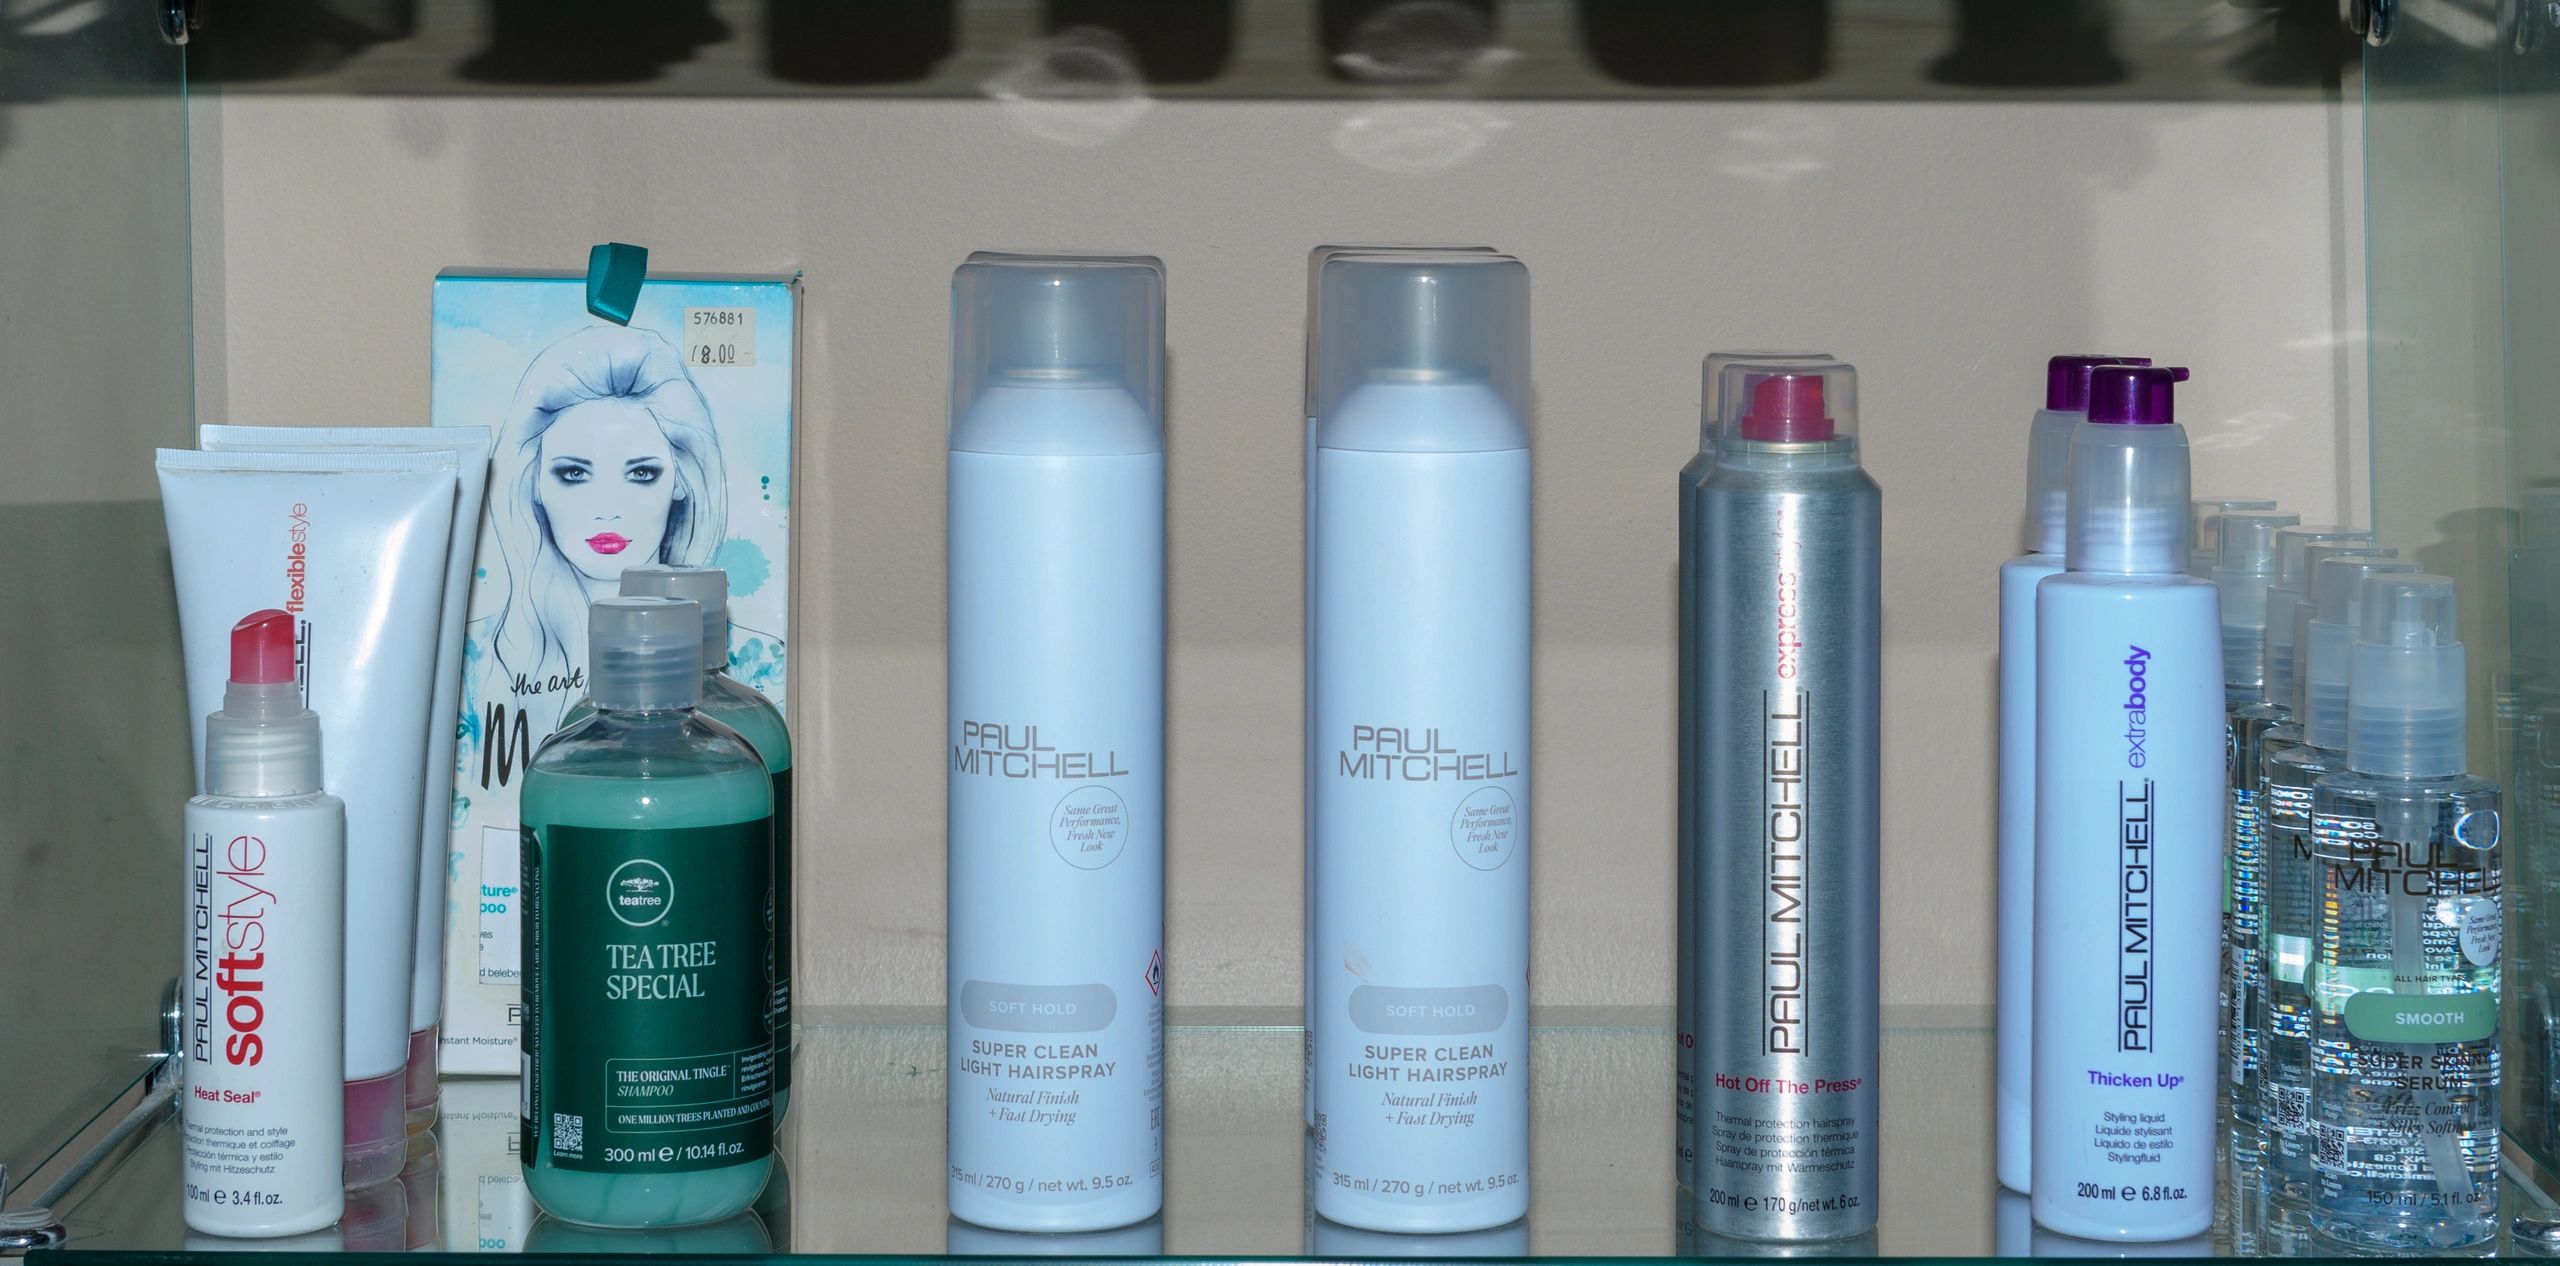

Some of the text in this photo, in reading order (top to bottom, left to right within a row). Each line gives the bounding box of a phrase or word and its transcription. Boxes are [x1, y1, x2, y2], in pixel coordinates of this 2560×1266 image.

[694, 312, 743, 326] 576881
[510, 667, 584, 697] the art
[2124, 644, 2150, 768] extrabody
[964, 720, 1055, 750] PAUL
[1354, 725, 1456, 754] PAUL
[954, 746, 1129, 778] MITCHELL
[1340, 750, 1518, 782] MITCHELL
[1064, 803, 1118, 815] Same Great
[1464, 804, 1510, 817] Same Great
[1067, 829, 1115, 840] Fresh New
[1467, 829, 1508, 842] Fresh New
[1080, 842, 1104, 852] Look
[1478, 842, 1498, 854] Look
[2350, 842, 2458, 868] PAUL
[619, 895, 662, 906] teatree
[216, 835, 276, 1066] softstyle
[606, 942, 716, 970] TEA TREE
[606, 974, 705, 1000] SPECIAL
[1770, 933, 1801, 1053] PAUL
[989, 1001, 1076, 1016] SOFT HOLD
[1386, 1005, 1475, 1018] SOFT HOLD
[2124, 960, 2148, 1051] PAUL
[195, 987, 210, 1062] PAUL
[2396, 1012, 2464, 1025] SMOOTH
[972, 1040, 1098, 1059] SUPER CLEAN
[1365, 1044, 1493, 1062] SUPER CLEAN
[617, 1071, 638, 1082] THE
[640, 1069, 692, 1082] ORIGINAL
[960, 1058, 1116, 1080] LIGHT HAIRSPRAY
[1349, 1062, 1507, 1082] LIGHT HAIRSPRAY
[1716, 1072, 1740, 1090] Hot
[1745, 1078, 1770, 1092] Off
[1776, 1080, 1808, 1094] The
[2088, 1071, 2152, 1086] Thicken
[194, 1086, 221, 1103] Heat
[617, 1085, 674, 1096] SHAMPOO
[986, 1088, 1080, 1105] Natural Finish
[1382, 1090, 1477, 1107] Natural Finish
[618, 1105, 750, 1124] ONE MILLION TREES PLANTED AND
[998, 1107, 1077, 1126] Fast Drying
[1397, 1111, 1474, 1128] Fast Drying
[1716, 1112, 1855, 1131] Thermal protection hairspray
[2104, 1112, 2165, 1124] Styling liquid
[205, 1127, 288, 1136] protection and style
[1712, 1126, 1859, 1145] Spray de protection thermique
[2096, 1124, 2172, 1137] Liquide stylisant
[206, 1138, 296, 1150] thermique et coiffage
[1716, 1141, 1740, 1156] Spray
[1744, 1145, 1756, 1156] de
[2134, 1140, 2173, 1148] de estilo
[252, 1155, 257, 1163] y
[260, 1152, 284, 1160] estilo
[604, 1148, 634, 1162] 300
[638, 1149, 655, 1161] ml
[686, 1144, 714, 1159] 10.14
[2108, 1152, 2160, 1164] Stylingfluid
[210, 1164, 221, 1172] mit
[224, 1165, 276, 1174] Hitzeschutz
[1716, 1157, 1782, 1173] Haarspray mit
[964, 1172, 976, 1185] ml
[986, 1176, 1012, 1190] 270
[1015, 1180, 1024, 1193] g
[1038, 1179, 1062, 1192] net
[1066, 1178, 1088, 1192] wt.
[1092, 1176, 1114, 1190] 9.5
[1117, 1174, 1133, 1187] oz.
[1333, 1172, 1519, 1196] 315 ml 270 g net wt. 9.5 oz.
[2078, 1182, 2099, 1198] 200
[2102, 1186, 2115, 1200] ml
[2142, 1185, 2160, 1200] 6.8
[200, 1189, 210, 1202] ml
[232, 1190, 250, 1206] 3.4
[1710, 1188, 1726, 1206] 200
[1728, 1195, 1740, 1207] ml
[1764, 1197, 1784, 1212] 170
[1822, 1198, 1838, 1210] wt.
[1840, 1194, 1846, 1208] 6
[1848, 1196, 1860, 1207] oz.
[2368, 1190, 2393, 1204] 150
[2399, 1193, 2416, 1205] ml
